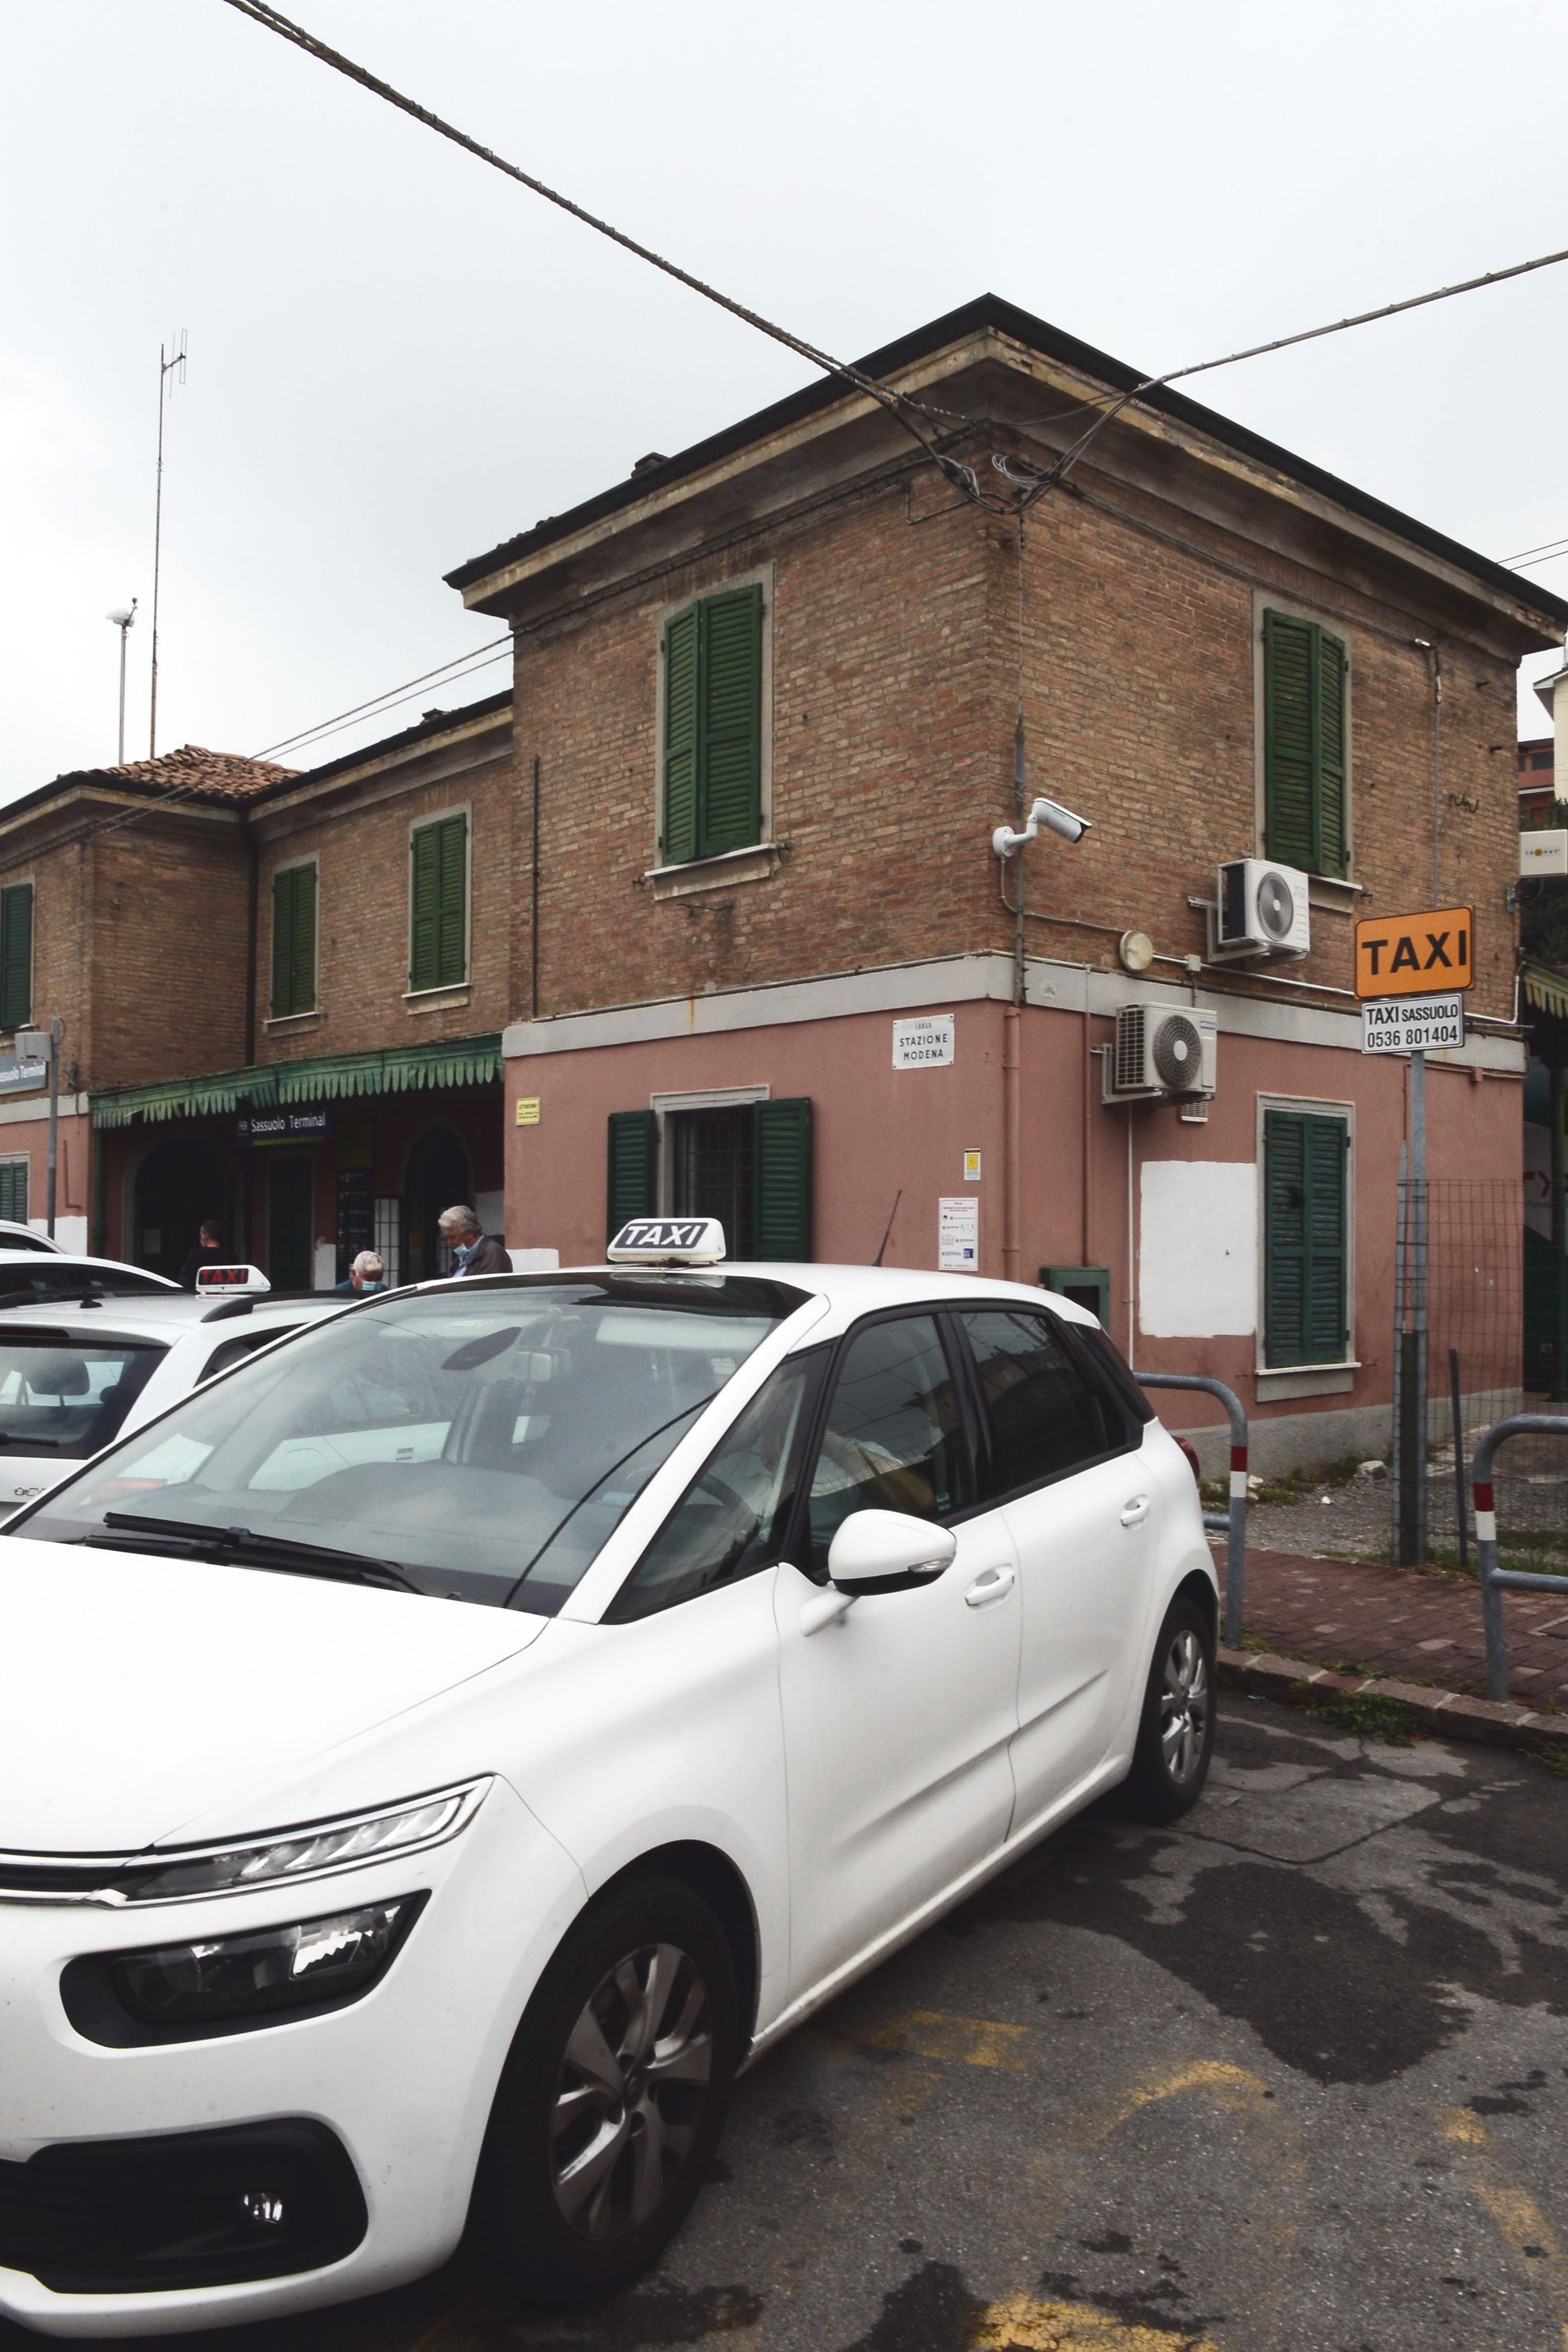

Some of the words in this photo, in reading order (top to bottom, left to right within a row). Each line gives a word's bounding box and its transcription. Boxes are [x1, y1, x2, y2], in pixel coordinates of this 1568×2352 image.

[1362, 930, 1467, 975] TAXI
[1366, 1007, 1399, 1025] TAXI
[1402, 1004, 1458, 1022] SASSUOLO
[900, 1034, 948, 1047] STAZIONE
[1367, 1031, 1401, 1047] 0536
[1406, 1025, 1458, 1044] 801404
[903, 1049, 944, 1061] MODENA
[251, 1116, 285, 1132] Sassuolo
[289, 1111, 326, 1129] Terminal
[625, 1225, 701, 1246] TAXI
[201, 1270, 247, 1284] TAXI
